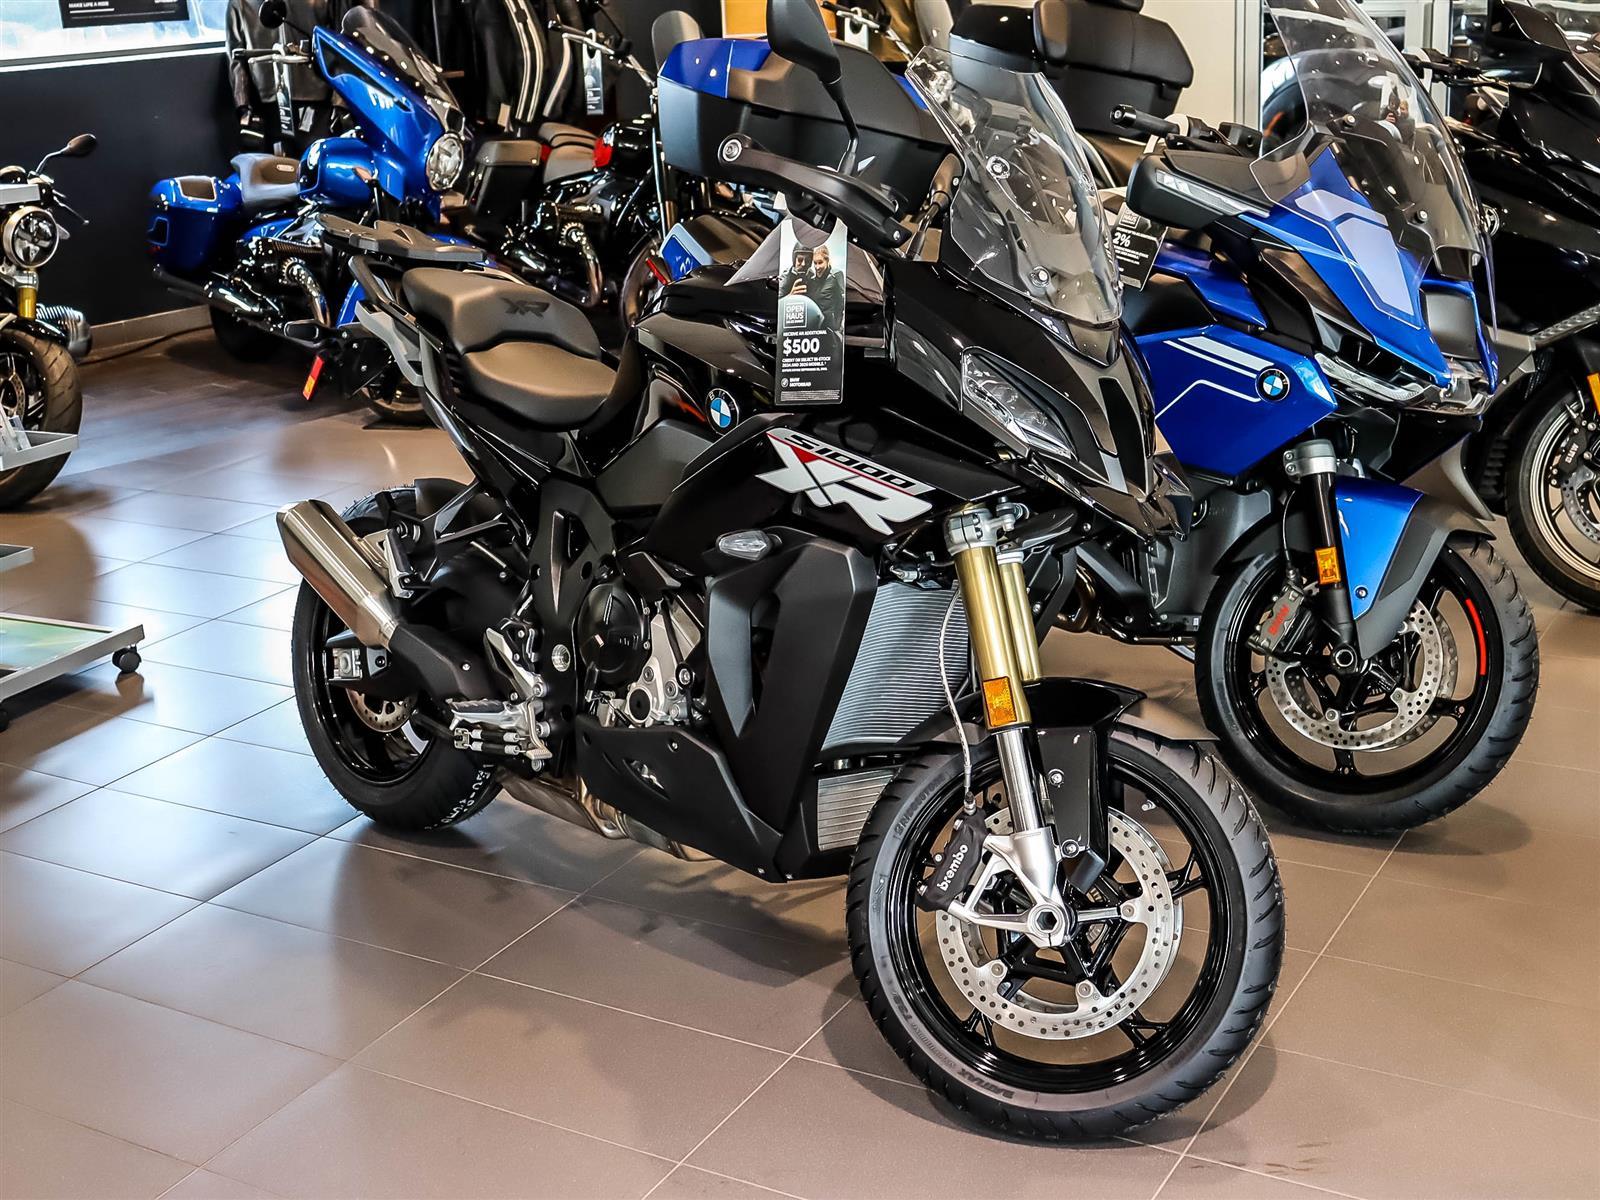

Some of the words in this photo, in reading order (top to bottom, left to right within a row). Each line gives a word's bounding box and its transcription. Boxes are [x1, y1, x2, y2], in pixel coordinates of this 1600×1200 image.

[786, 304, 804, 313] OPEN
[786, 312, 804, 320] HAUS
[783, 337, 820, 356] $500
[785, 434, 916, 489] S1000
[755, 432, 932, 536] XR
[937, 844, 968, 891] brembo
